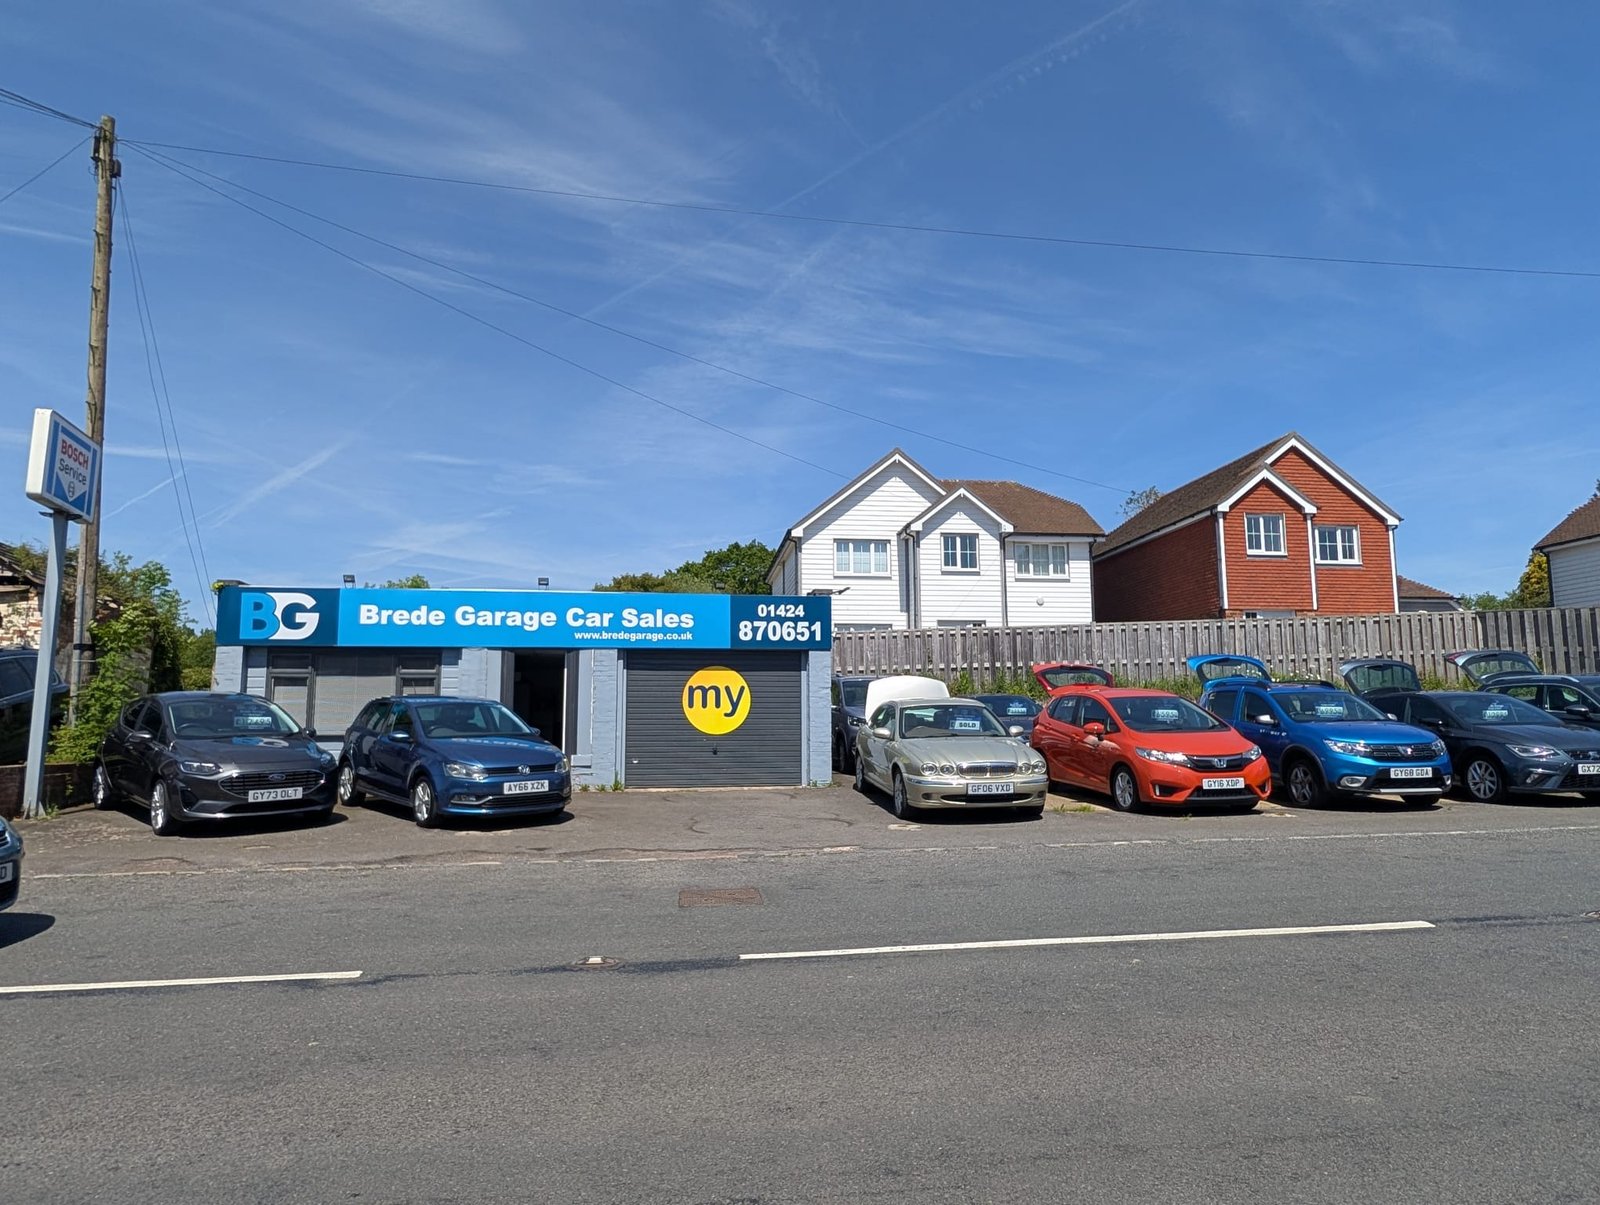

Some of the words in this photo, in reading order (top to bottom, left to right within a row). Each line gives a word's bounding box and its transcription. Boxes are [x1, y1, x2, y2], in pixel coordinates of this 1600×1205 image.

[61, 439, 89, 470] BOSCH
[58, 458, 87, 486] Service
[239, 592, 320, 640] BG
[359, 604, 446, 626] Brede
[455, 605, 557, 632] Garage
[566, 607, 614, 628] Car
[621, 608, 695, 629] Sales
[757, 604, 805, 618] 01424
[574, 630, 693, 642] www.bredegarage.co.uk
[738, 621, 822, 641] 870651
[687, 685, 746, 717] my
[1393, 768, 1414, 777] GY68
[507, 783, 529, 792] AY66
[530, 781, 546, 790] XZK
[971, 784, 994, 793] GF06
[994, 783, 1011, 792] VXD
[1207, 779, 1225, 788] GY16
[252, 790, 279, 801] GY73
